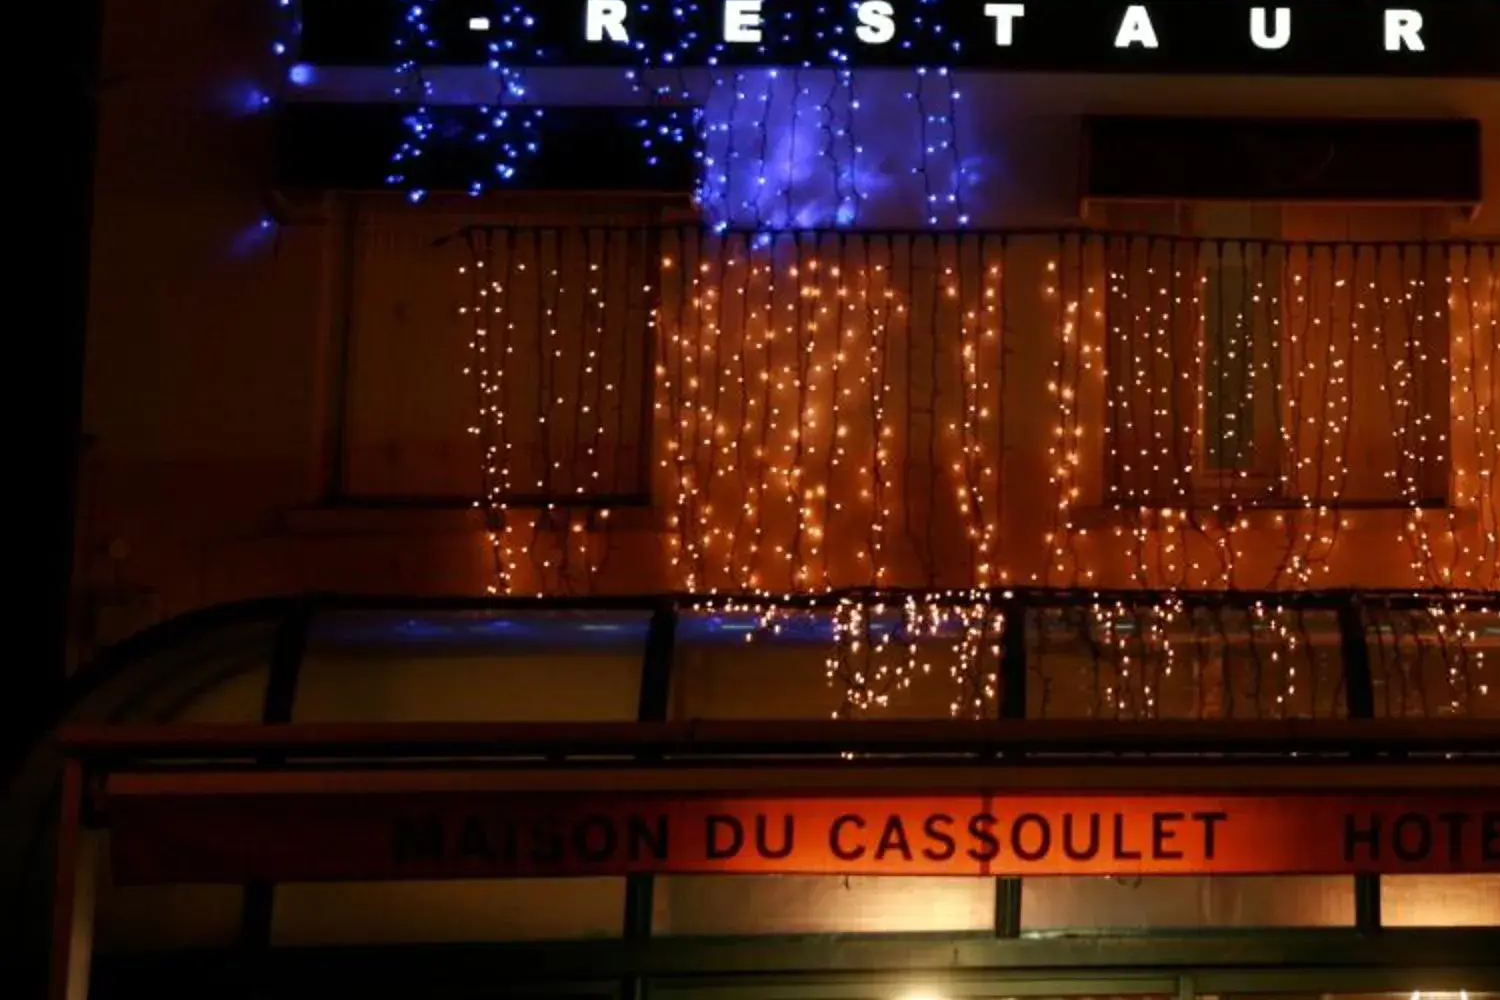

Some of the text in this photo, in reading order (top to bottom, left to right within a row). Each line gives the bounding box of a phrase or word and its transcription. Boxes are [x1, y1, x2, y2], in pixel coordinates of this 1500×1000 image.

[394, 813, 670, 863] MAISON
[704, 813, 797, 862] DU
[828, 811, 1228, 864] CASSOULET
